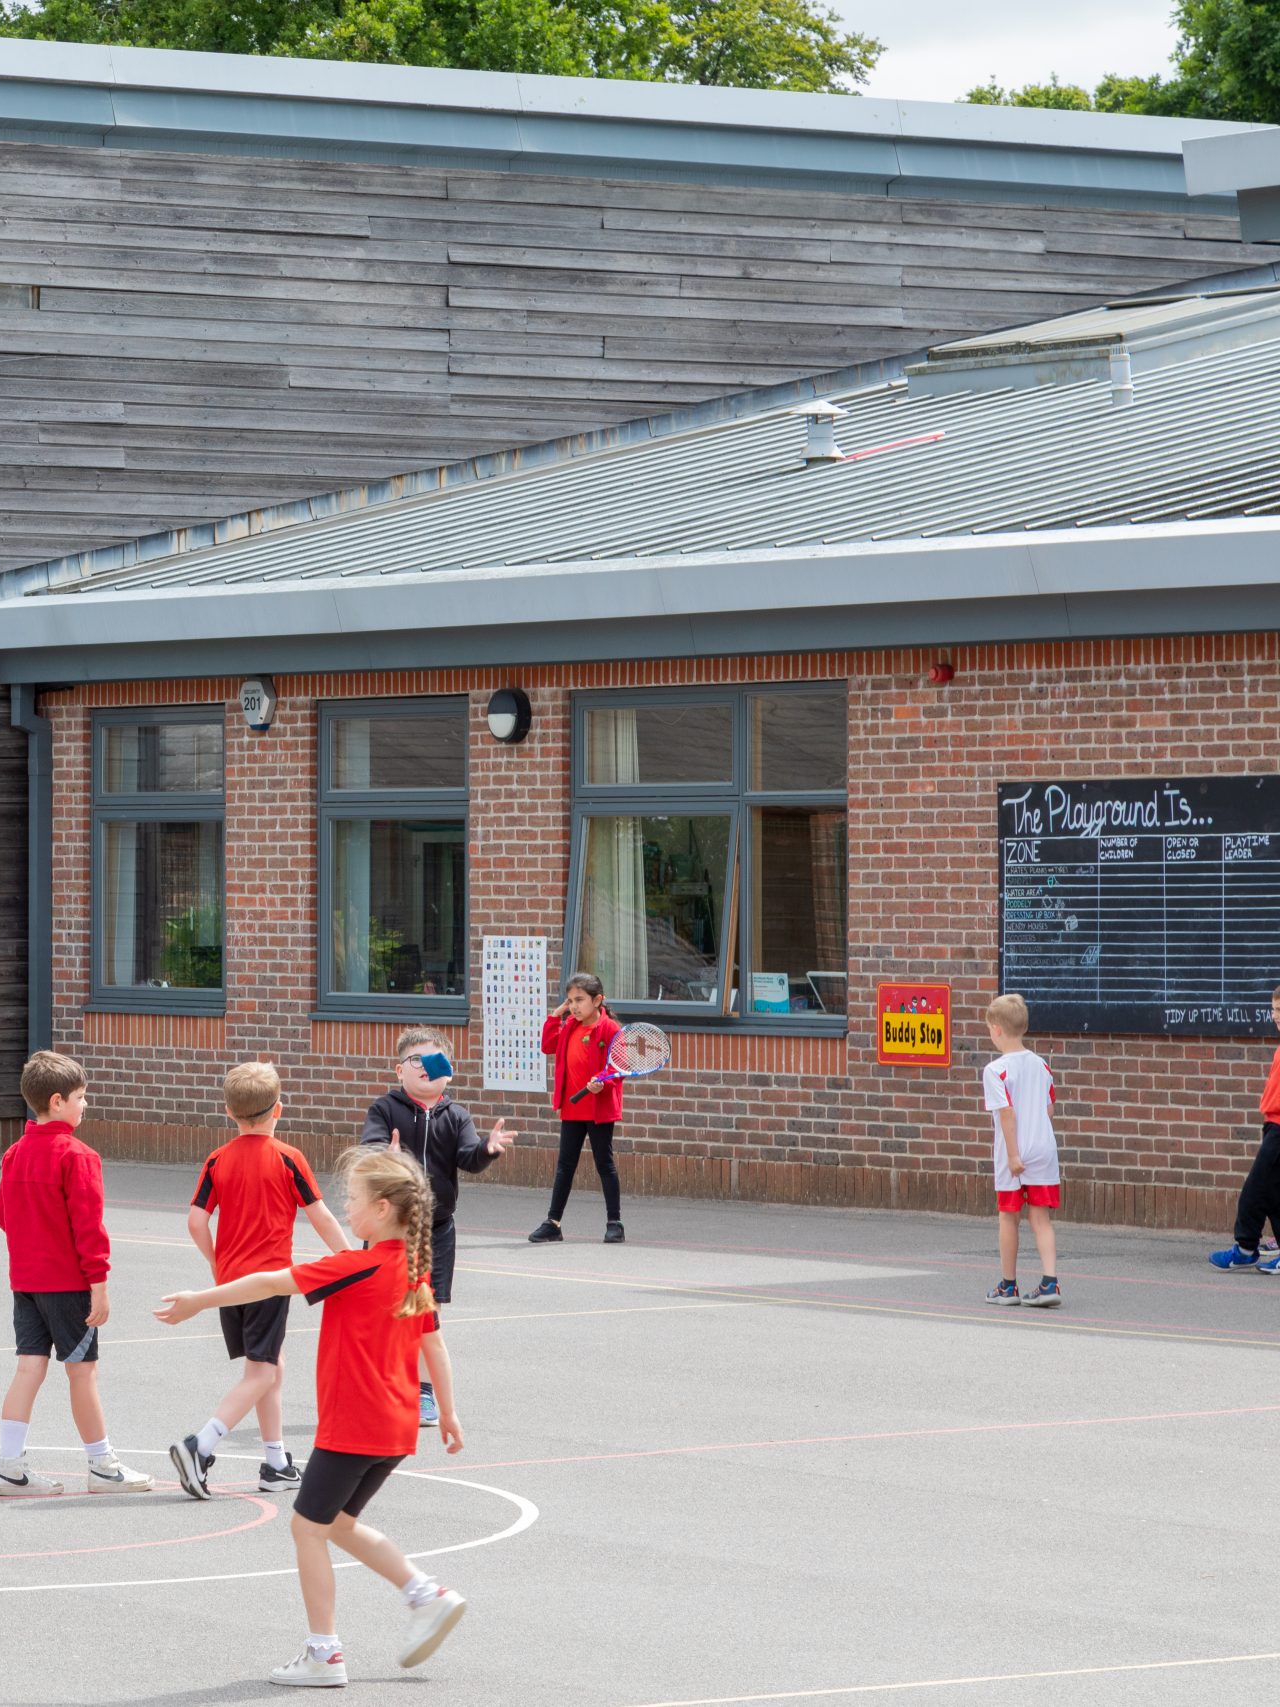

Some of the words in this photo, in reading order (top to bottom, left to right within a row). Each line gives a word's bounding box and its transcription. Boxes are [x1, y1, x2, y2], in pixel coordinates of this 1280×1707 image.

[244, 696, 261, 711] 201
[1002, 787, 1043, 835] The
[1044, 784, 1160, 837] Playground
[1100, 839, 1128, 848] NUMBER
[1129, 837, 1138, 847] OF
[1166, 837, 1187, 849] OPEN
[1188, 837, 1199, 847] OR
[1225, 835, 1270, 849] PLAYTIME
[1007, 841, 1041, 864] ZONE
[1100, 850, 1134, 860] CHILDREN
[1166, 848, 1196, 860] CLOSED
[1224, 848, 1253, 860] LEADER
[1006, 888, 1025, 897] WATER
[1006, 911, 1034, 919] DRESSING
[1043, 911, 1056, 919] BOX
[1006, 922, 1026, 931] WENDY
[1027, 922, 1049, 931] HOUSES
[1165, 1008, 1187, 1024] TIDY
[1188, 1008, 1199, 1024] UP
[1200, 1007, 1223, 1023] TIME
[1226, 1008, 1251, 1024] WILL
[1255, 1008, 1274, 1024] STA
[885, 1021, 916, 1048] Buddy
[920, 1022, 943, 1049] Stop
